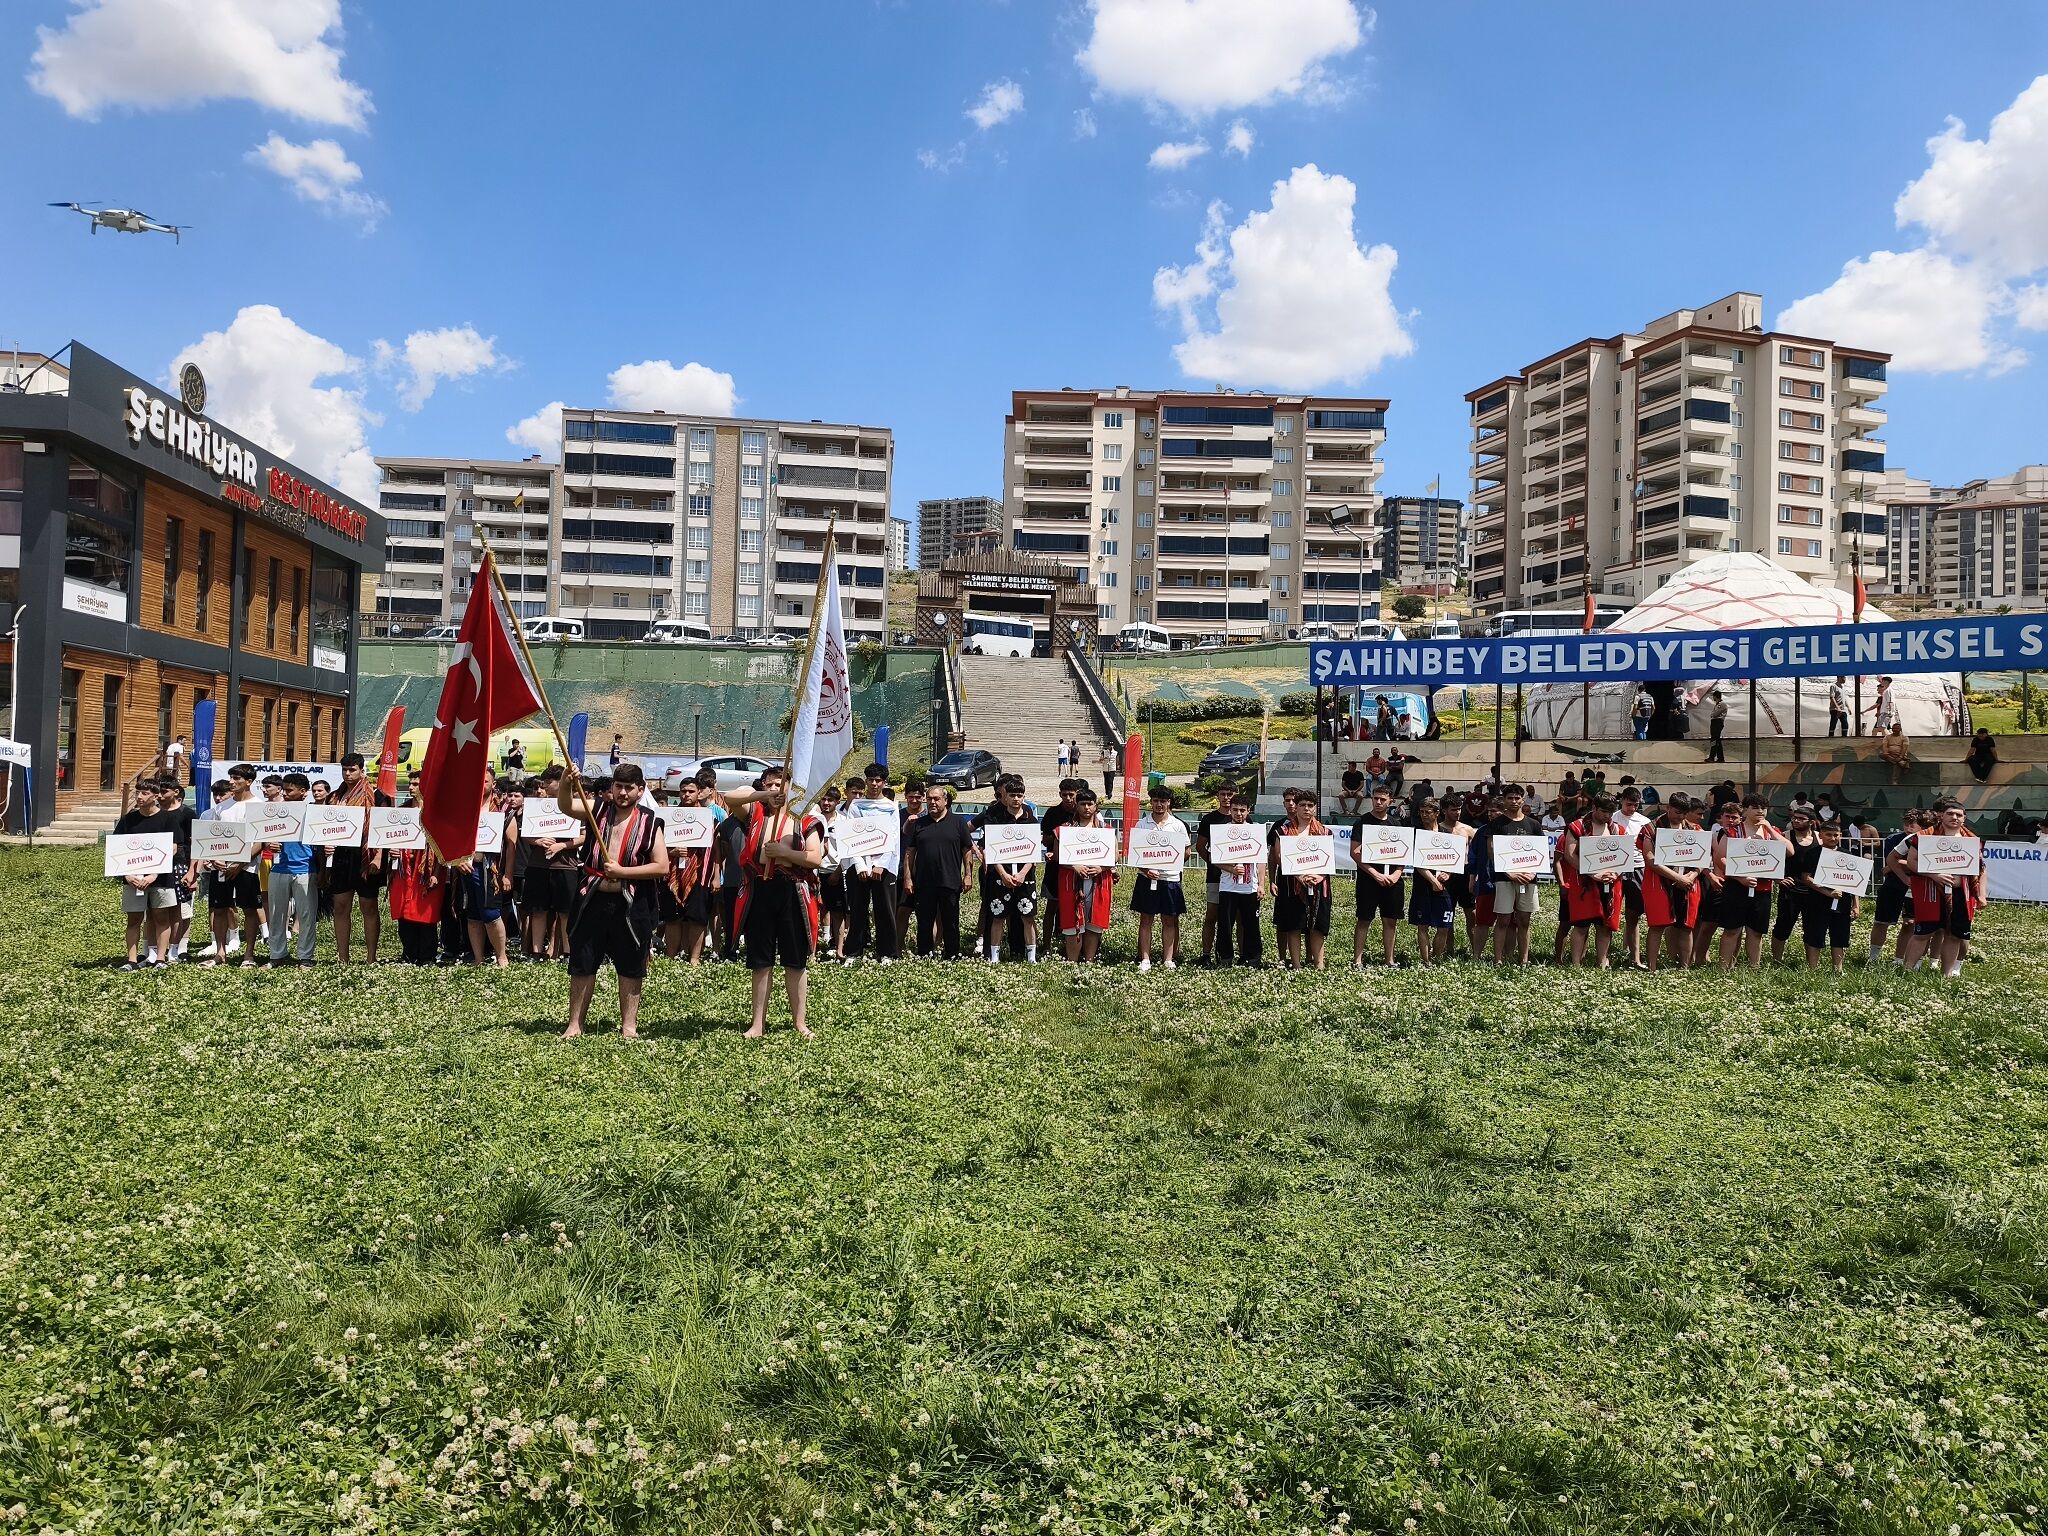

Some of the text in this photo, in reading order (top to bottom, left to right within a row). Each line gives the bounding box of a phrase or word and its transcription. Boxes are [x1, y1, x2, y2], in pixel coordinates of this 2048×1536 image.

[268, 466, 368, 542] RESTAURANT
[962, 580, 999, 588] GELENEKSEL
[1001, 582, 1029, 590] SPORLAR
[1762, 627, 2004, 667] GELENEKSEL
[253, 764, 324, 774] OKUL SPORLARI
[264, 823, 287, 833] BURSA
[322, 826, 347, 837] ÇORUM
[674, 827, 693, 837] HATAY
[386, 829, 409, 839] ELAZIĞ
[210, 843, 230, 851] AYDIN
[1228, 843, 1253, 853] MANİSA
[1675, 848, 1693, 856] SİVAS
[1142, 850, 1172, 858] MALATYA
[1599, 854, 1617, 864] SİNOP
[1982, 848, 2042, 861] OKULLAR
[126, 854, 153, 866] ARTVİN
[1511, 855, 1537, 864] SAMSUN
[1747, 858, 1767, 867] TOKAT
[1934, 855, 1966, 864] TRABZON
[1832, 872, 1855, 881] YALOVA
